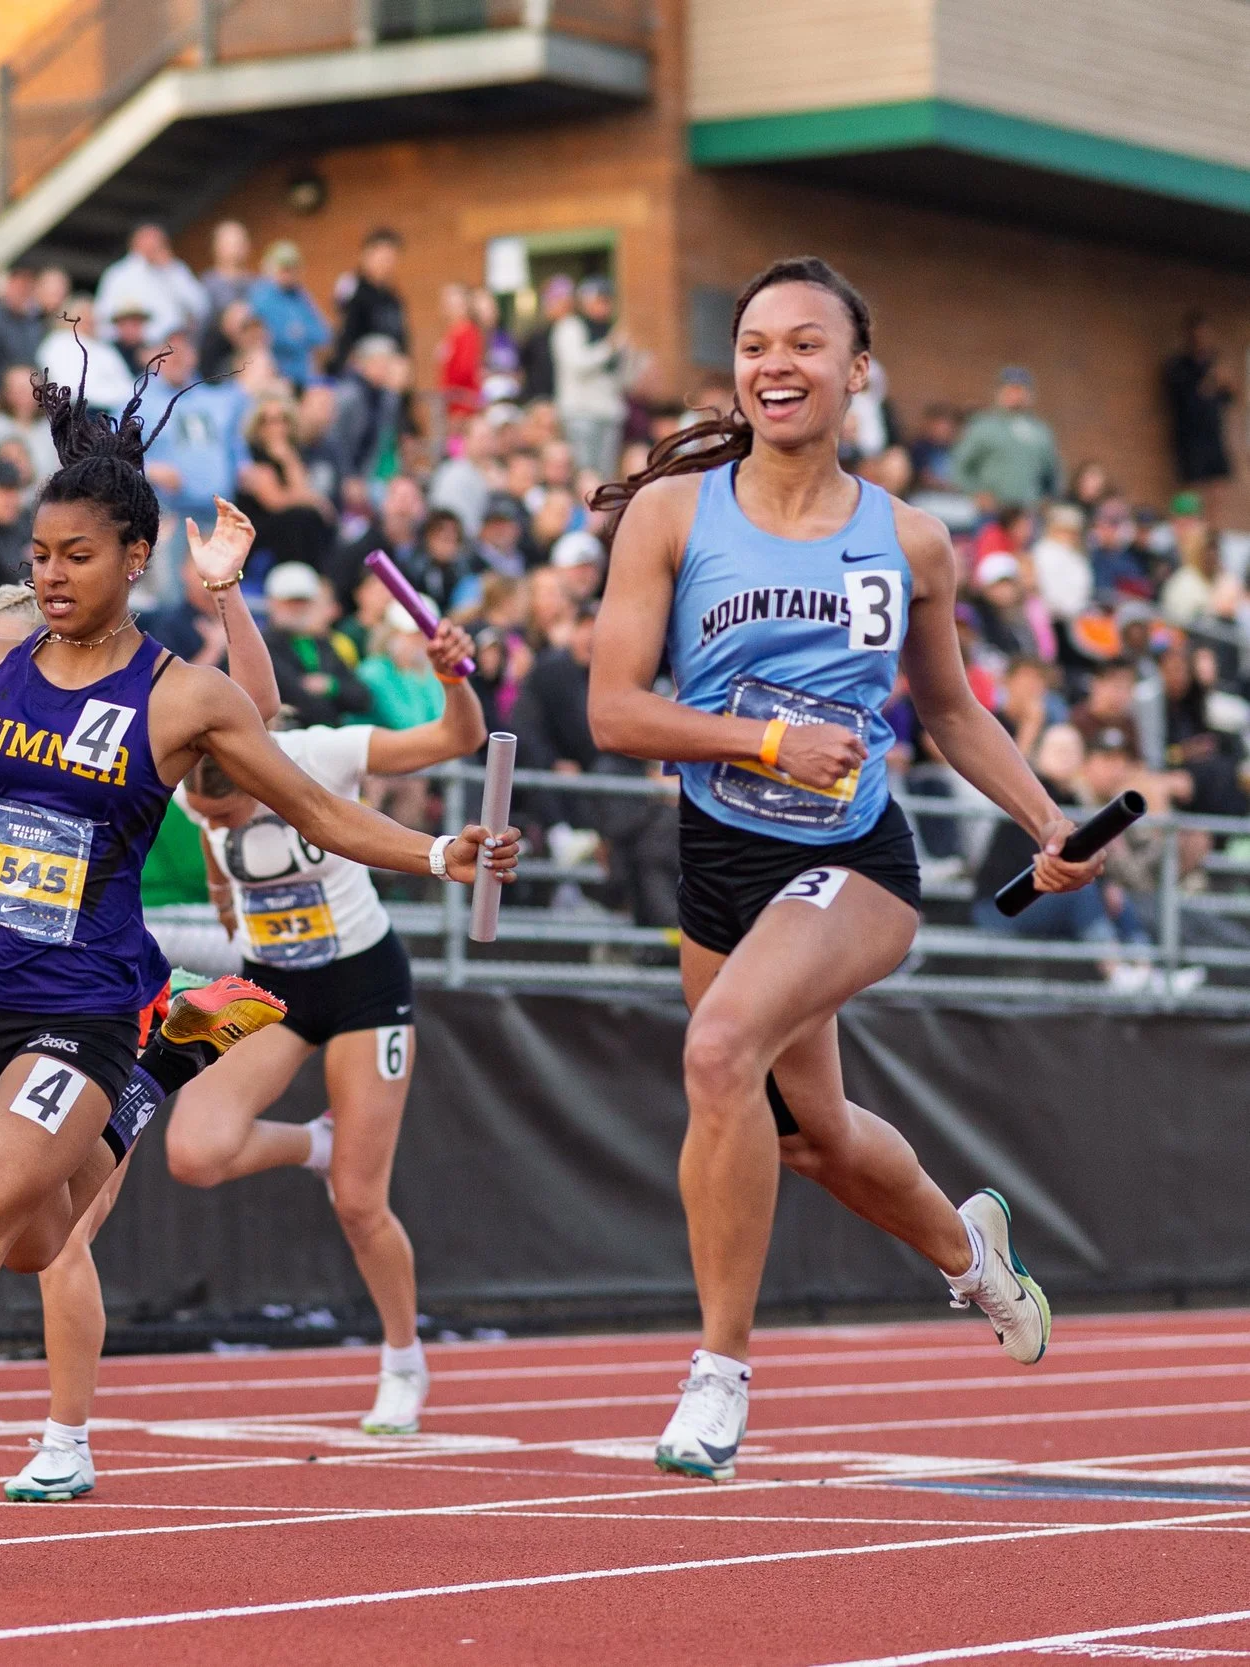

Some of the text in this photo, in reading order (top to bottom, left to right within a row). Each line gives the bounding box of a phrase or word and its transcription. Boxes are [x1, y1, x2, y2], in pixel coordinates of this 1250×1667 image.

[861, 575, 892, 646] 3
[76, 707, 121, 763] 4
[8, 822, 52, 838] TWILIGHT
[12, 830, 45, 843] RELAYS
[784, 871, 830, 897] 3
[387, 1031, 401, 1075] 6
[27, 1069, 73, 1122] 4
